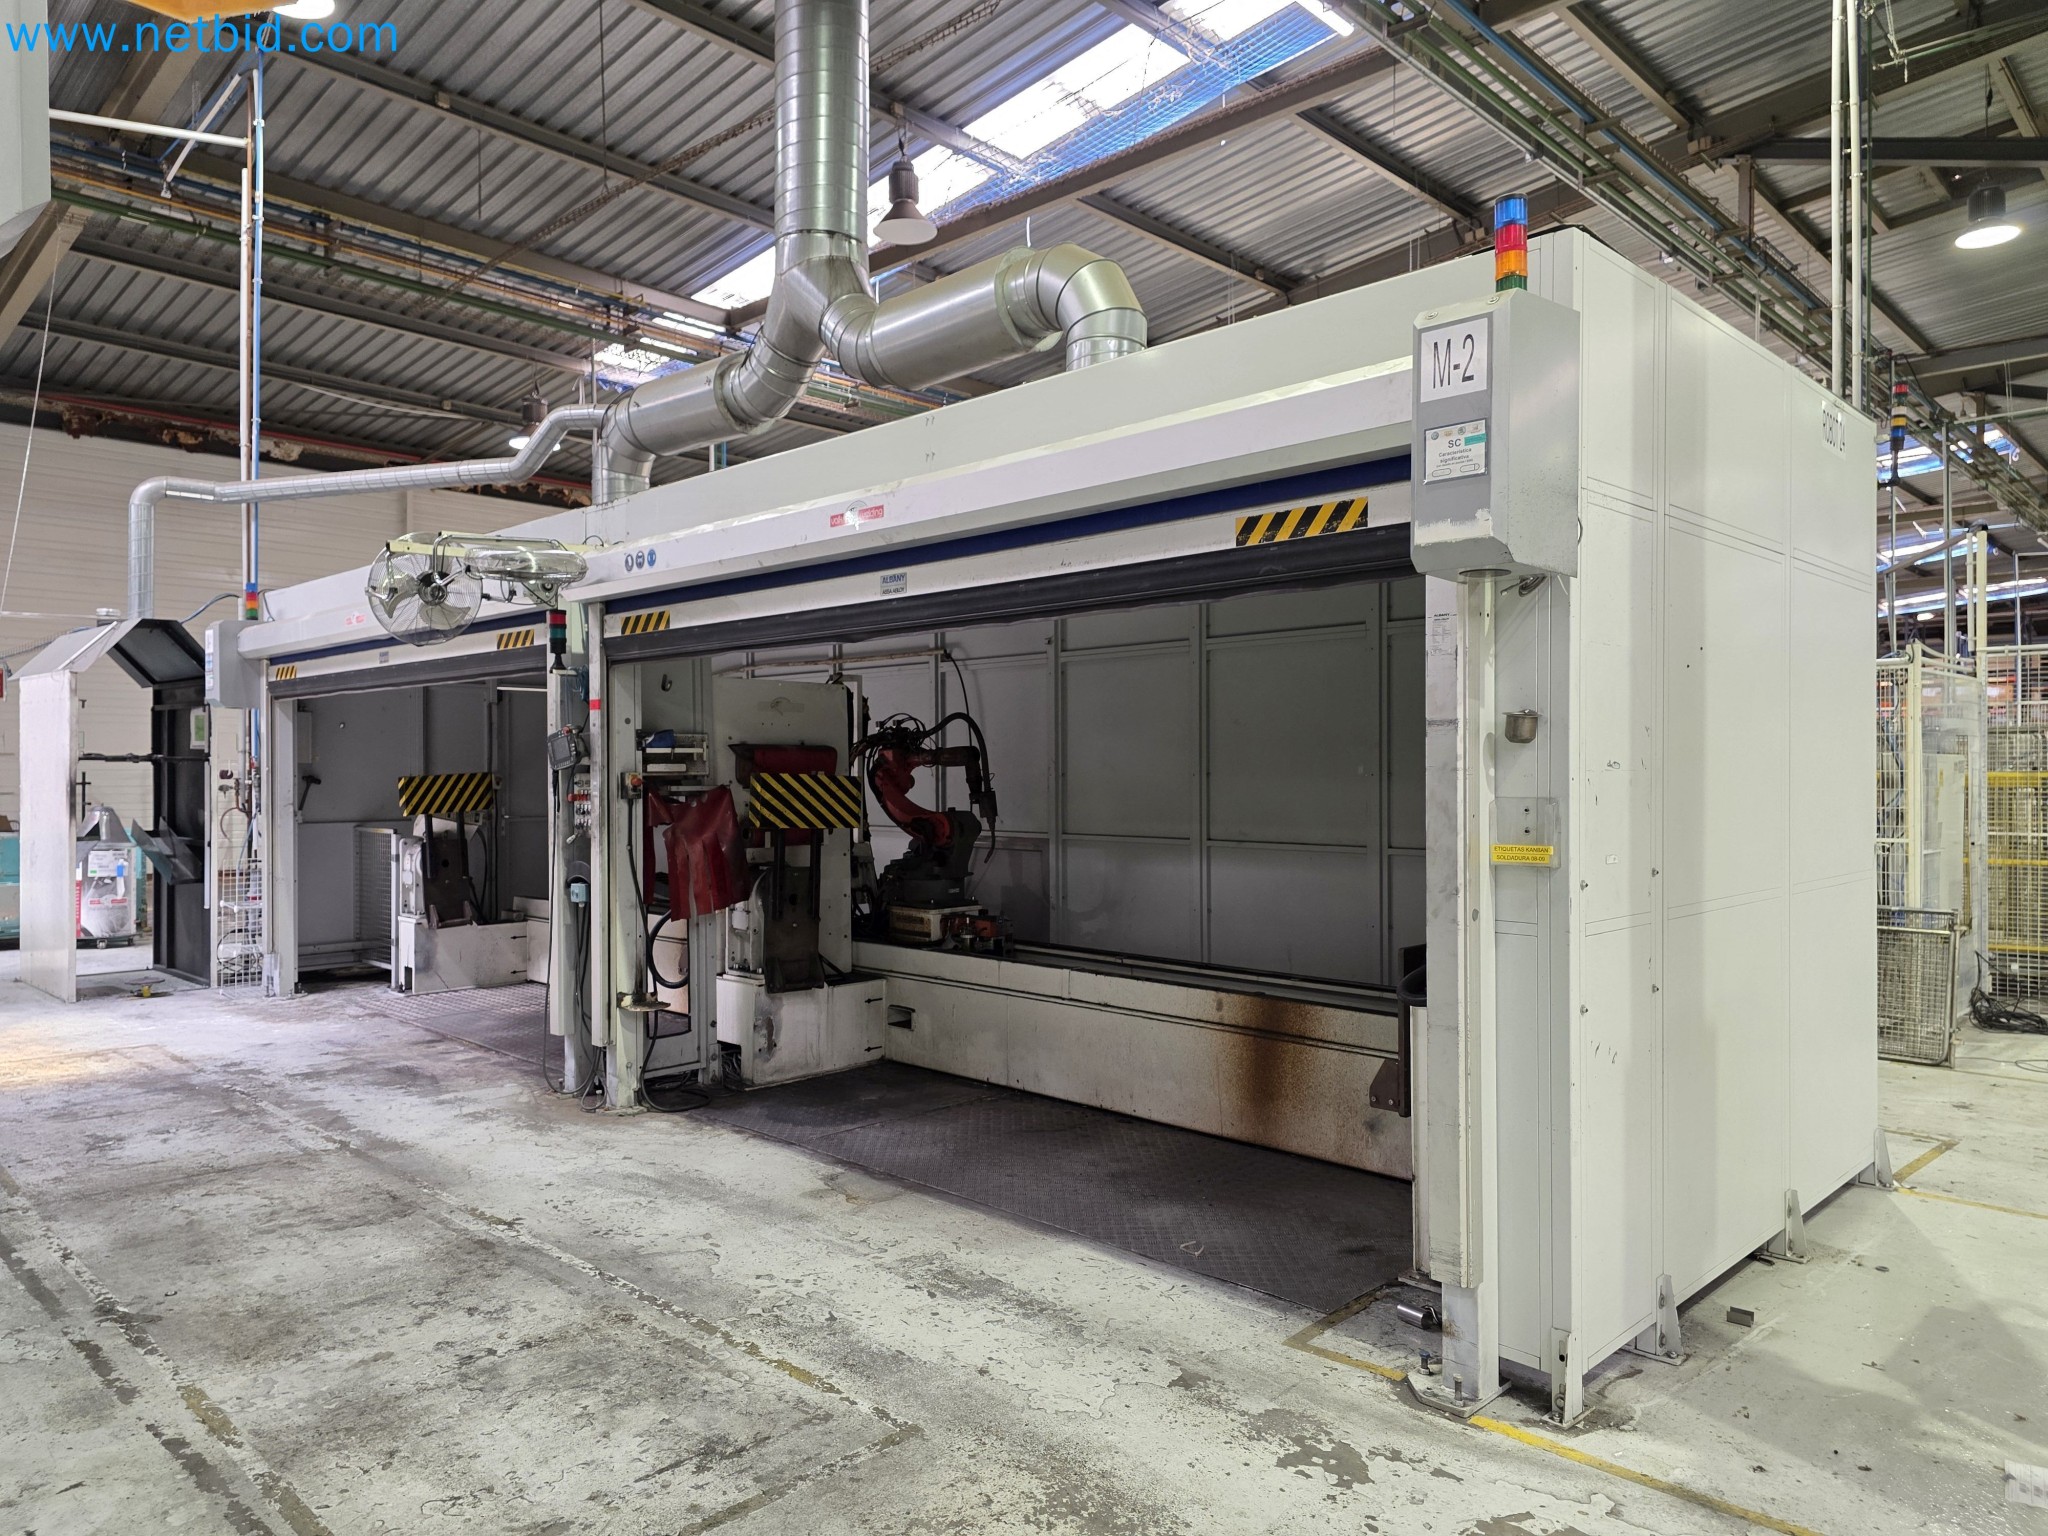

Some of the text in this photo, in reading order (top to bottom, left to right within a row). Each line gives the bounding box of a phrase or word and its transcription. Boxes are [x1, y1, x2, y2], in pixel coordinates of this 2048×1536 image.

[1433, 333, 1475, 389] M-2
[1447, 438, 1462, 448] SC
[882, 574, 905, 584] ALBANY
